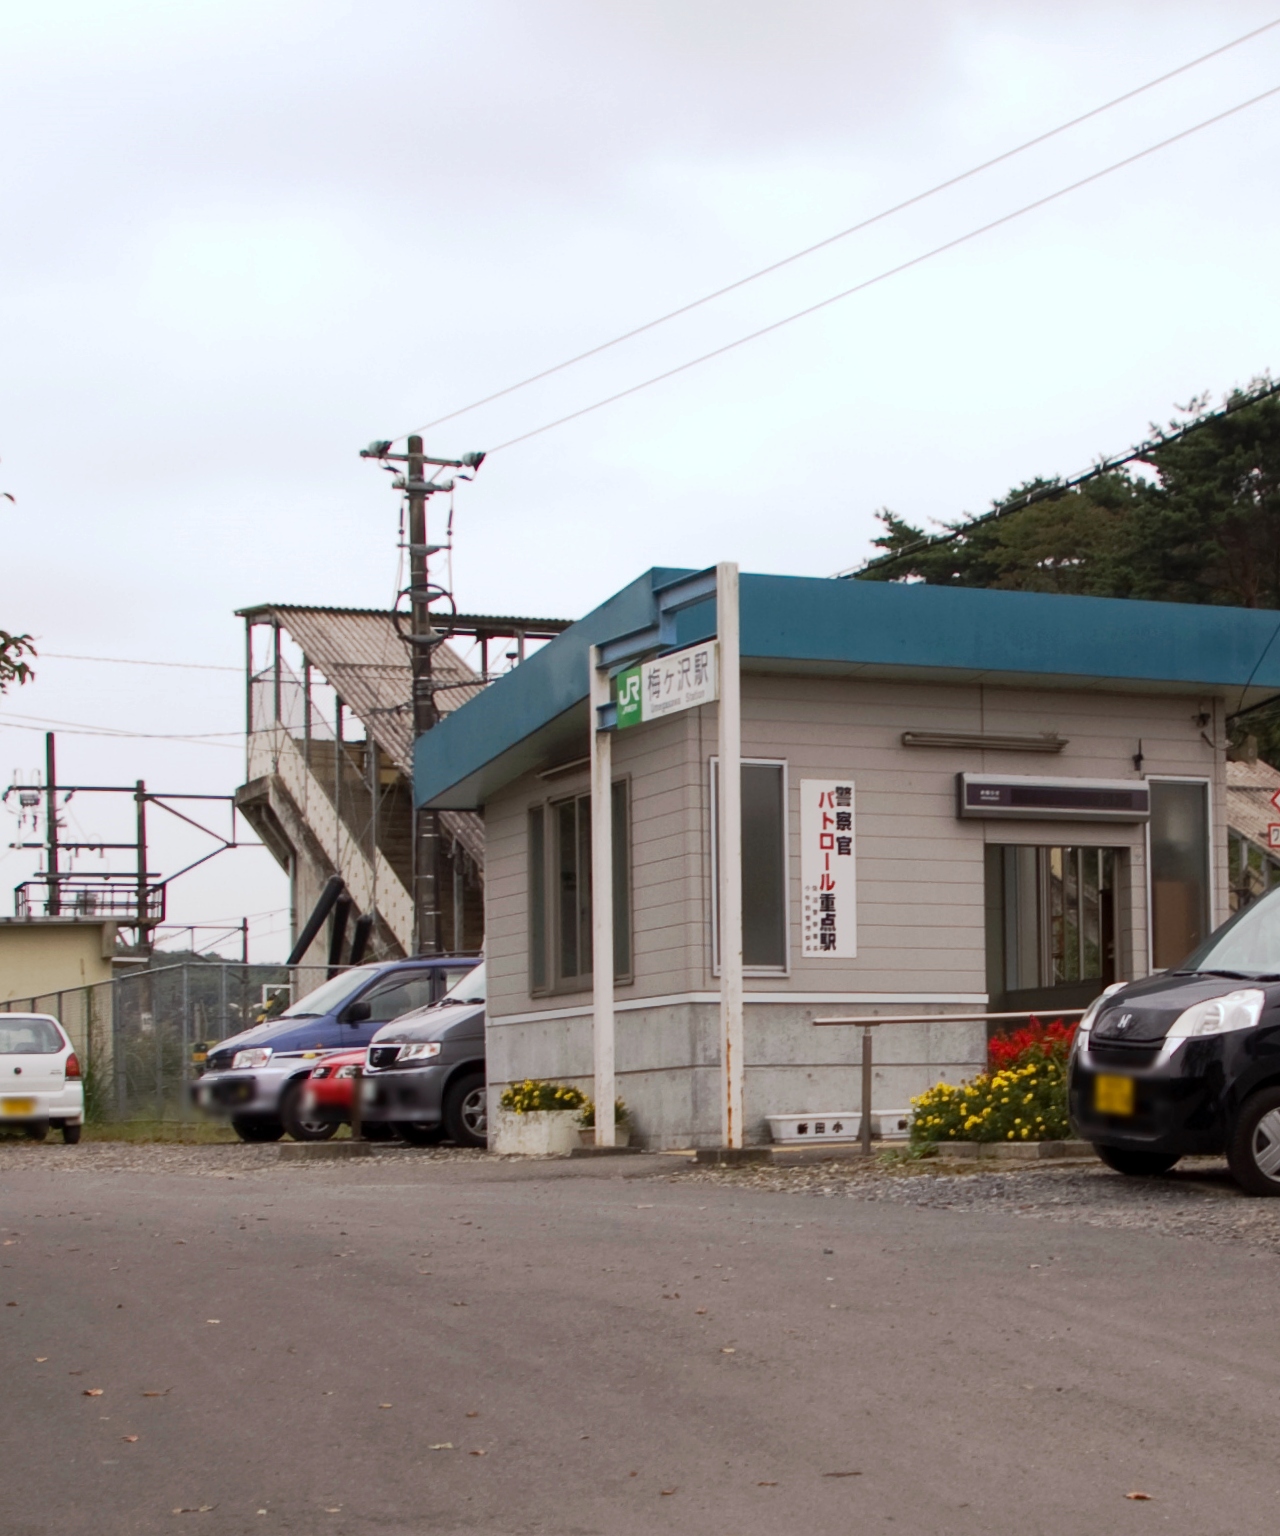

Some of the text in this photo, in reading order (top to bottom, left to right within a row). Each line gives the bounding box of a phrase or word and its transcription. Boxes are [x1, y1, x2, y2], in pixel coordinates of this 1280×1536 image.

[620, 675, 640, 706] JR
[835, 786, 852, 856] 警察官
[818, 790, 837, 951] パトロール重点駅
